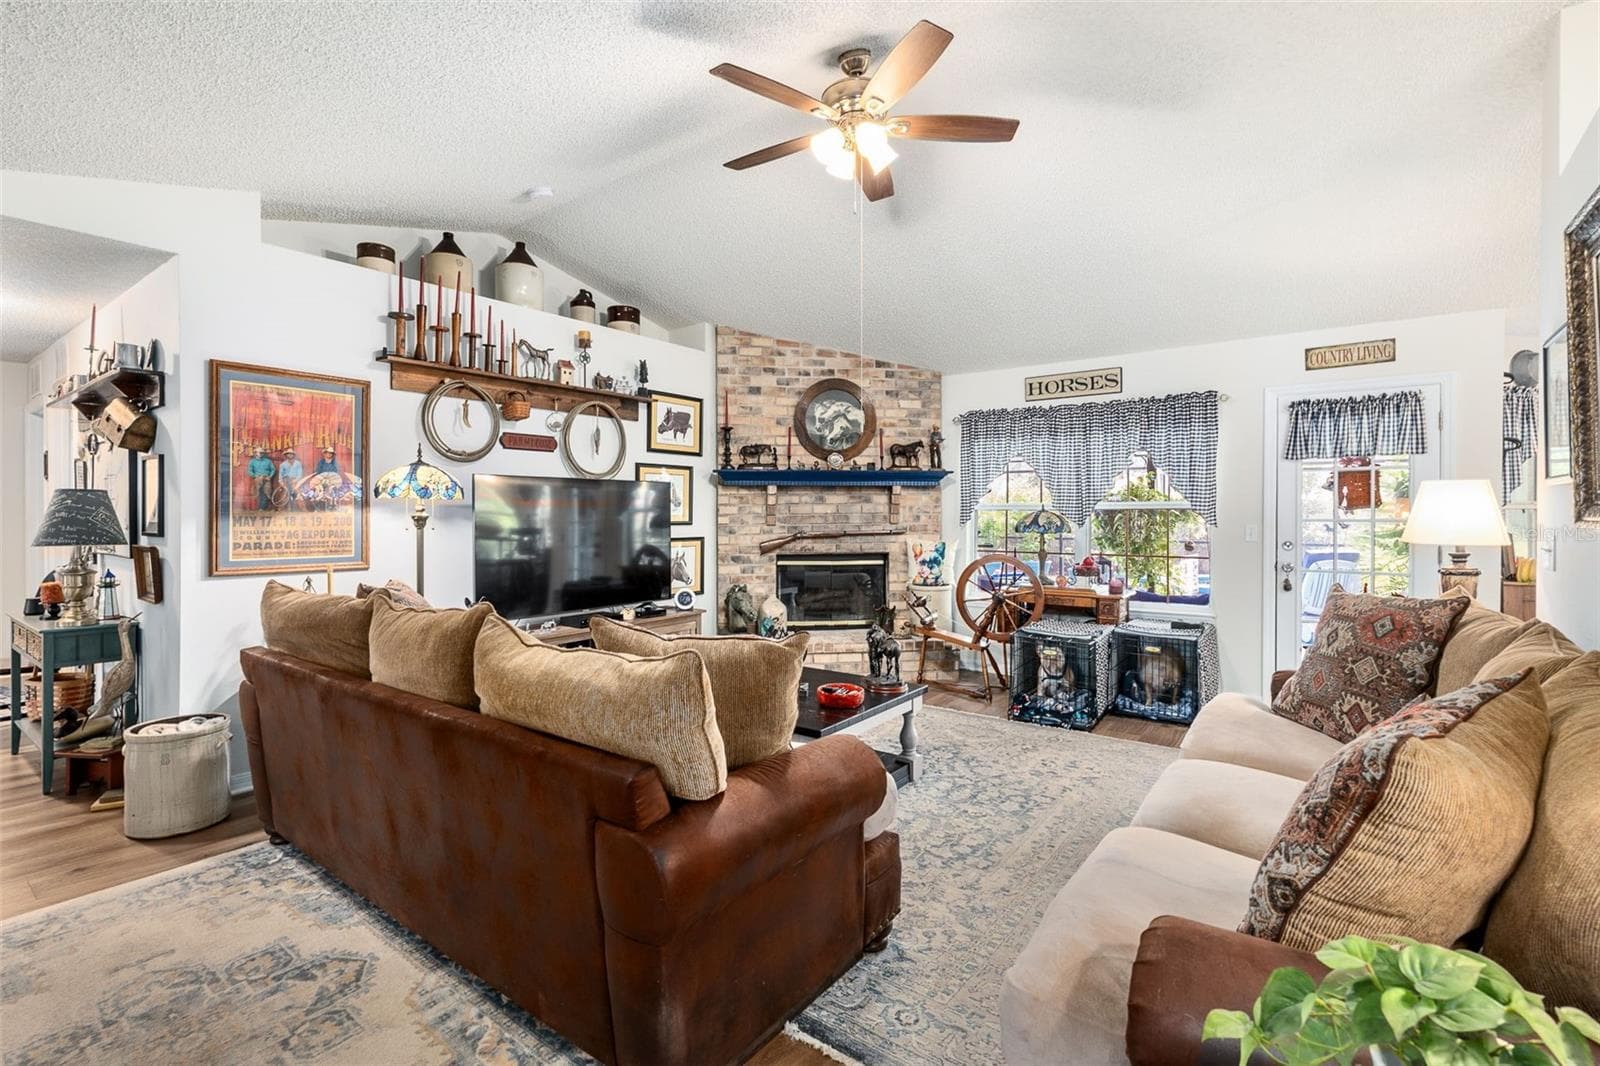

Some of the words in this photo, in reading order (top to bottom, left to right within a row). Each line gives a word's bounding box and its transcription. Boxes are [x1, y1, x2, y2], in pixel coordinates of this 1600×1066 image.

[1309, 347, 1354, 366] COUNTRY
[1357, 343, 1391, 361] LIVING
[1028, 373, 1119, 396] HORSES
[232, 515, 257, 528] MAY
[301, 529, 326, 540] EXPO
[327, 529, 352, 539] PARK
